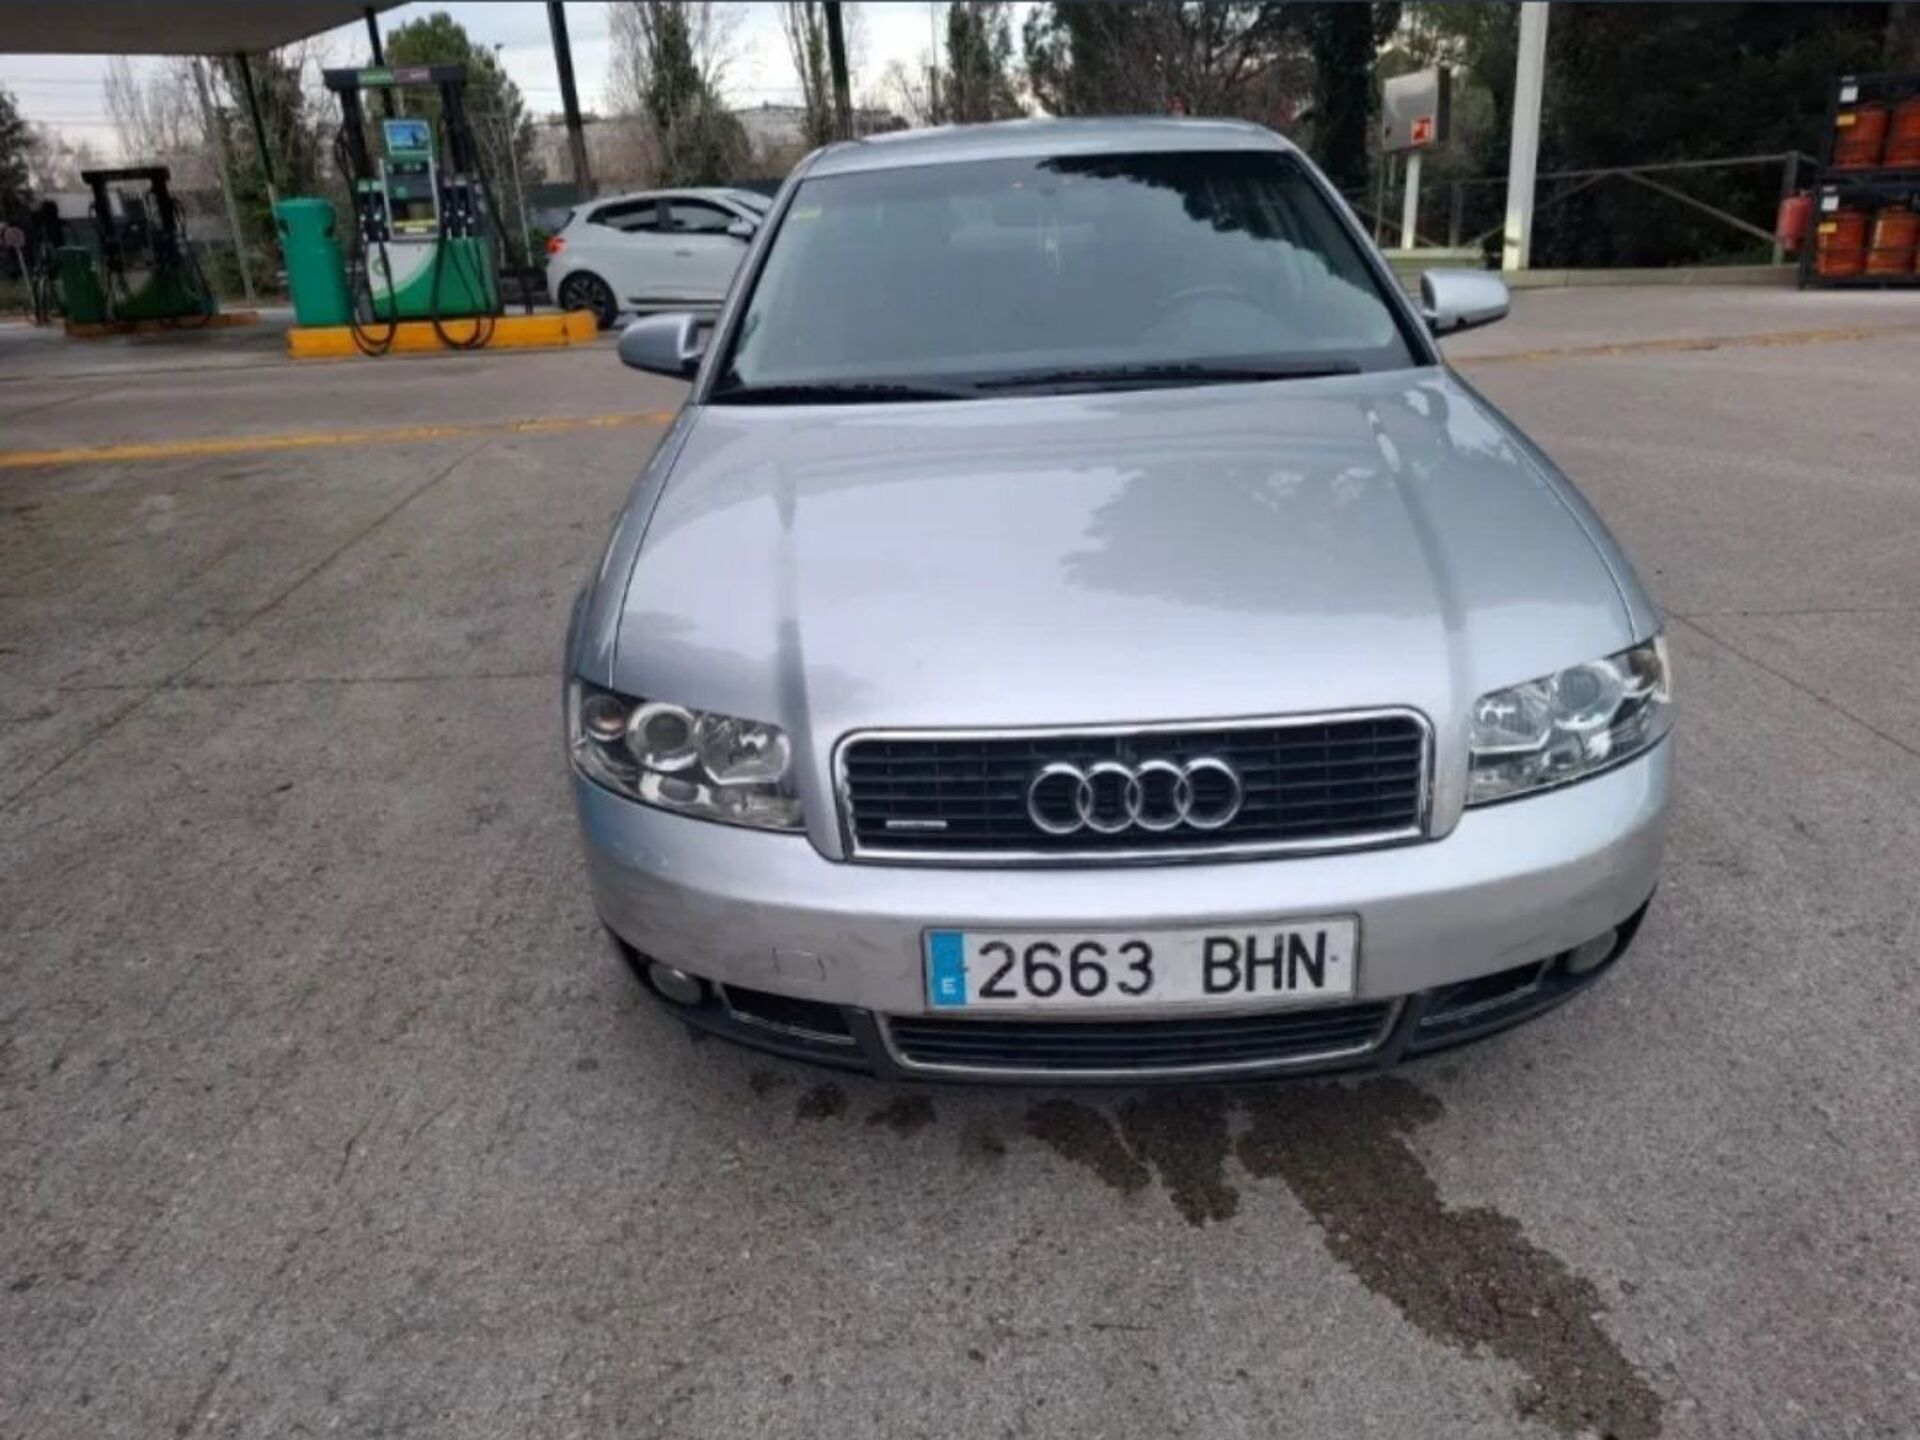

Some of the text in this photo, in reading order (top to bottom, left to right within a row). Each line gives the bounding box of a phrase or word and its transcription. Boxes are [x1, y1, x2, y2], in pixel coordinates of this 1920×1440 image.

[978, 931, 1326, 998] 2663 BHN
[941, 977, 957, 995] E
